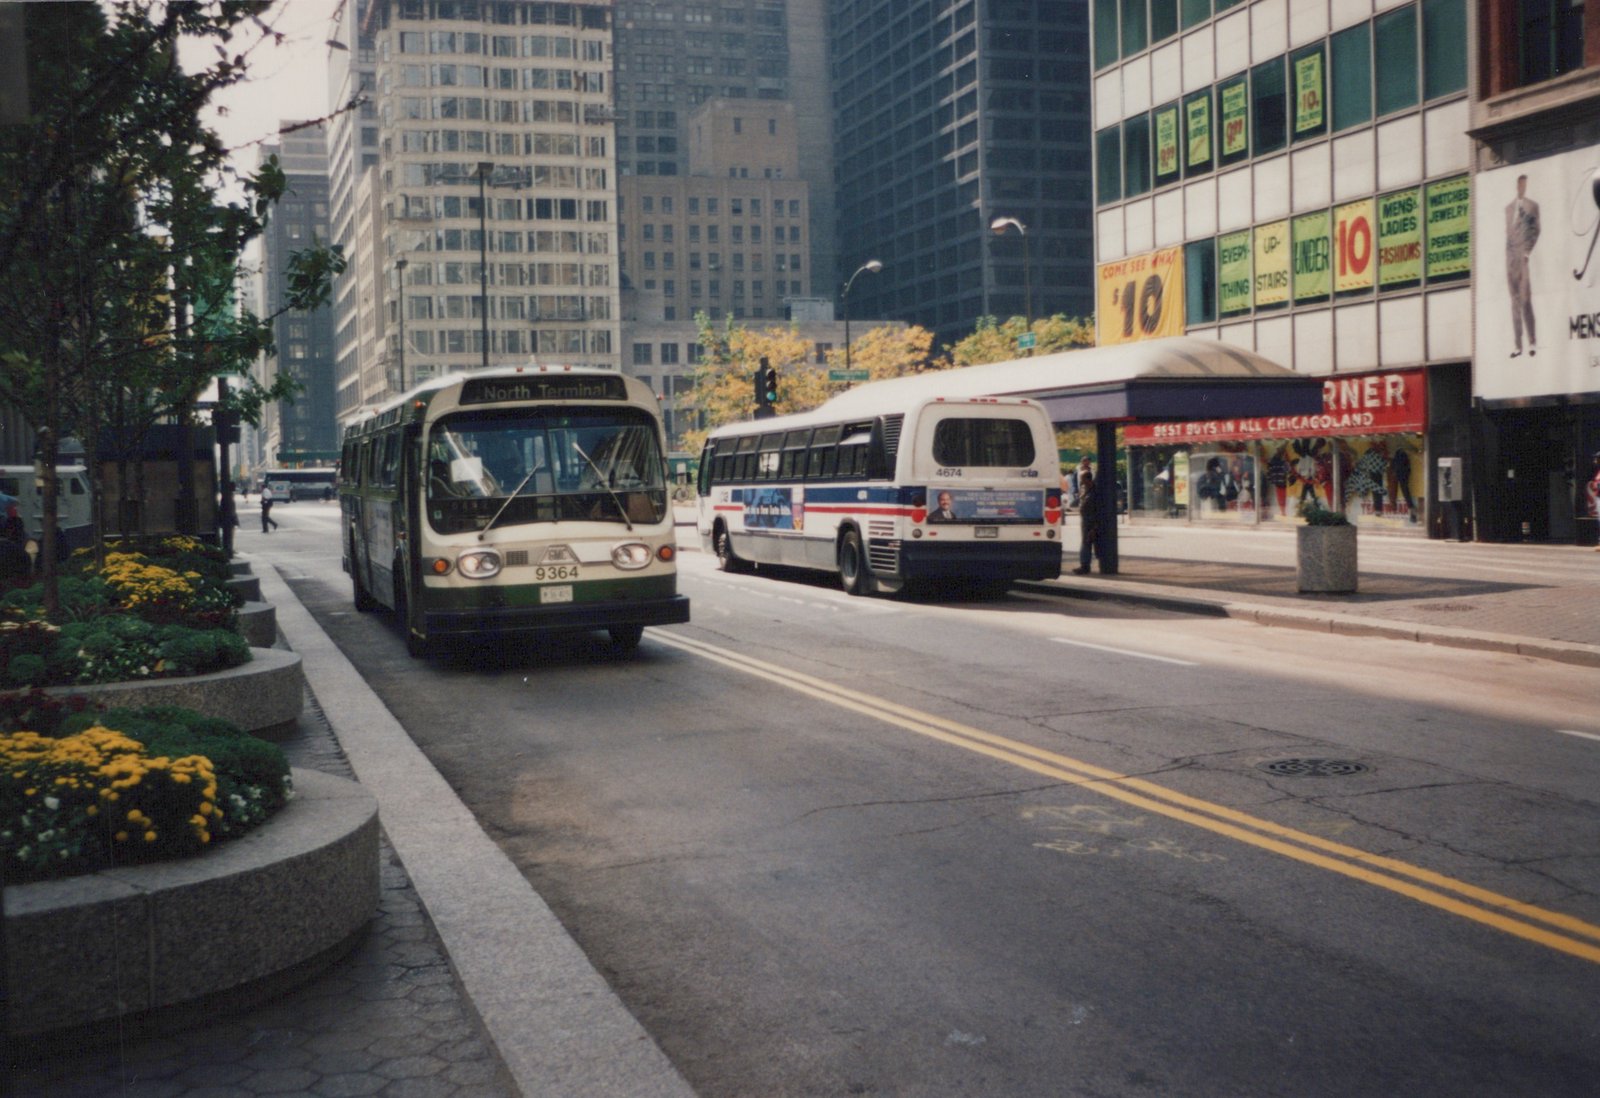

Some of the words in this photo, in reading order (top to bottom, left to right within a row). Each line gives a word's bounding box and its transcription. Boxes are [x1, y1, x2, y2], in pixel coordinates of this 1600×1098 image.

[1430, 188, 1469, 208] WATCHES
[1429, 203, 1469, 224] JEWELRY
[1380, 216, 1417, 238] LADIES
[1263, 236, 1280, 254] UP-
[1338, 216, 1371, 276] 10
[1431, 231, 1469, 249] PERFUME
[1294, 236, 1330, 275] UNDER
[1379, 241, 1421, 266] FASHIONS
[1428, 246, 1469, 265] SOUVENIRS
[1103, 263, 1128, 280] COME
[1131, 258, 1147, 274] SEE
[1221, 278, 1249, 299] THING
[1257, 270, 1288, 292] STAIRS
[484, 385, 531, 399] North
[538, 382, 607, 398] Terminal
[1153, 424, 1181, 437] BEST
[1186, 421, 1217, 436] BUYS
[1222, 420, 1235, 433] IN
[1240, 417, 1262, 432] ALL
[1267, 412, 1373, 431] CHICAGOLAND
[936, 468, 963, 478] 4674
[1021, 468, 1039, 478] cta
[535, 566, 579, 581] 9364
